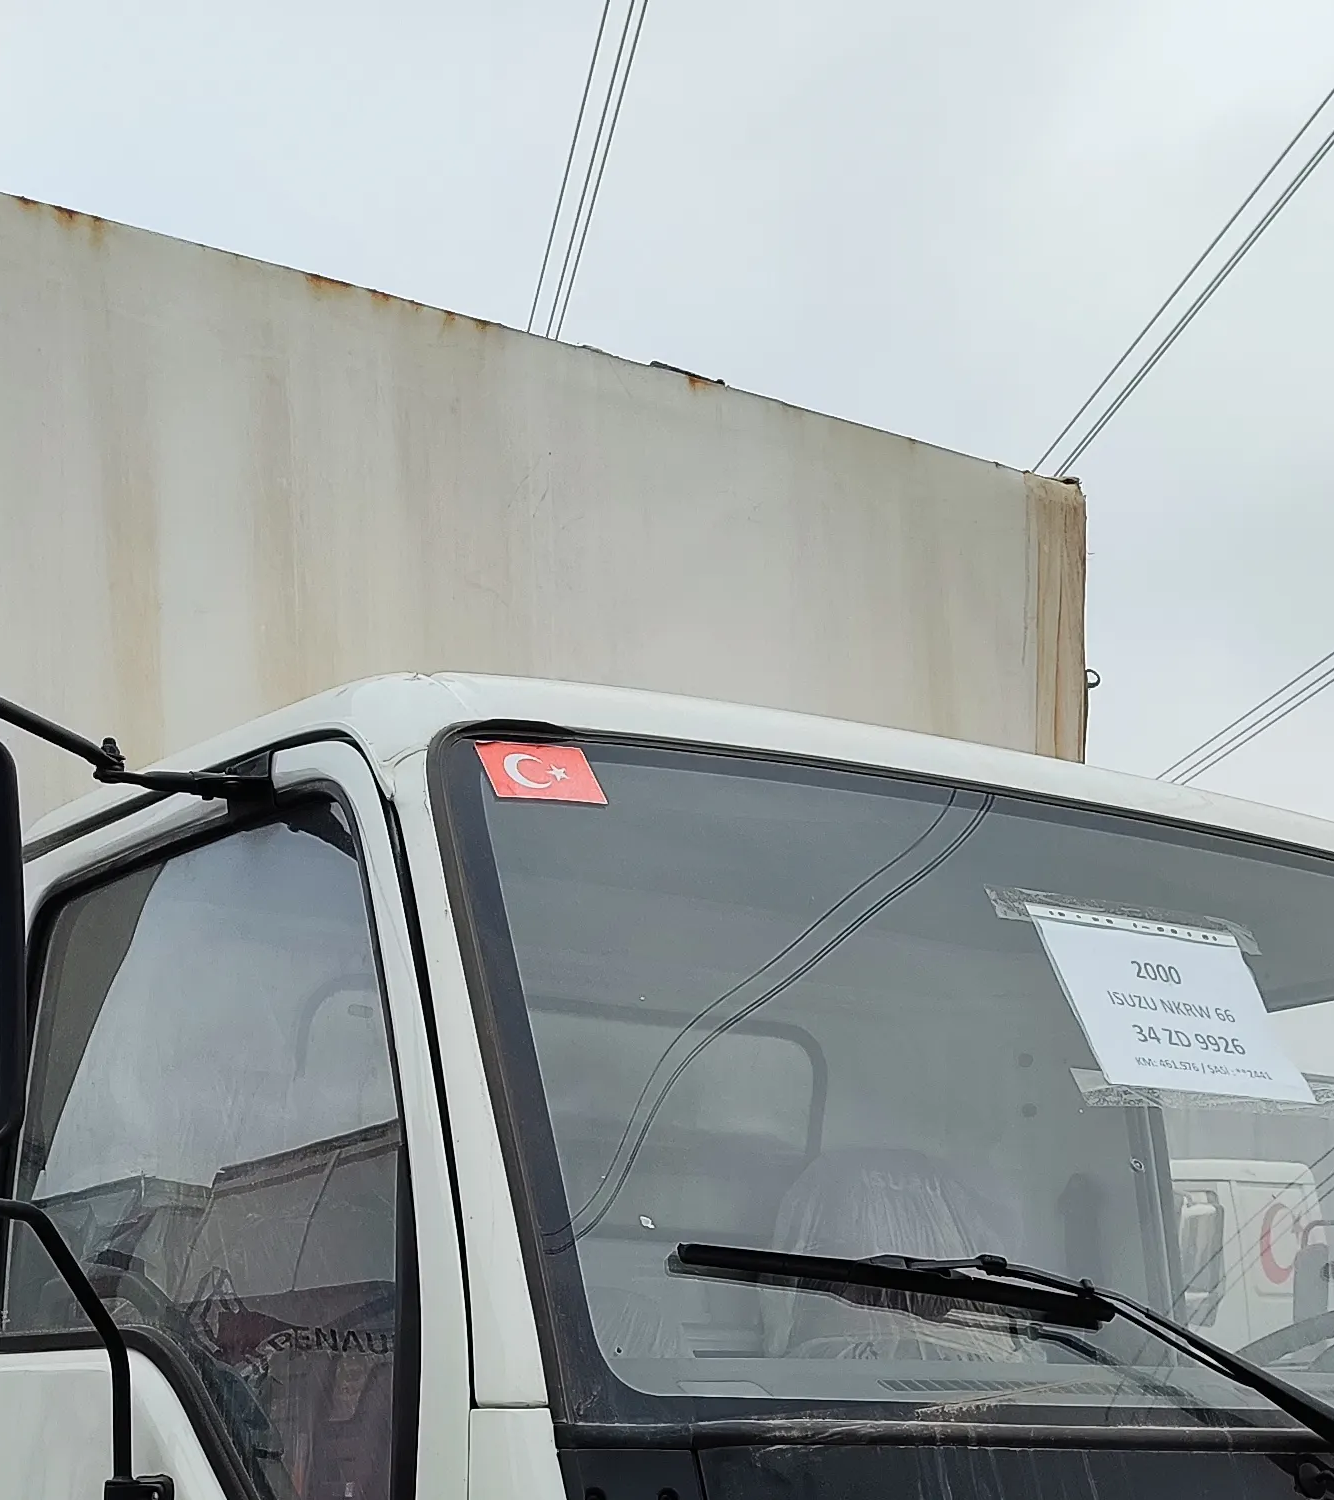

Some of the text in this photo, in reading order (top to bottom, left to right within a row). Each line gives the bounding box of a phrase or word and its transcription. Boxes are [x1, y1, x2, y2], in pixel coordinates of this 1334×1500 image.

[1130, 960, 1182, 985] 2000
[1107, 990, 1236, 1023] ISUZU NKRW 66
[1132, 1024, 1246, 1055] 34 ZD 9926
